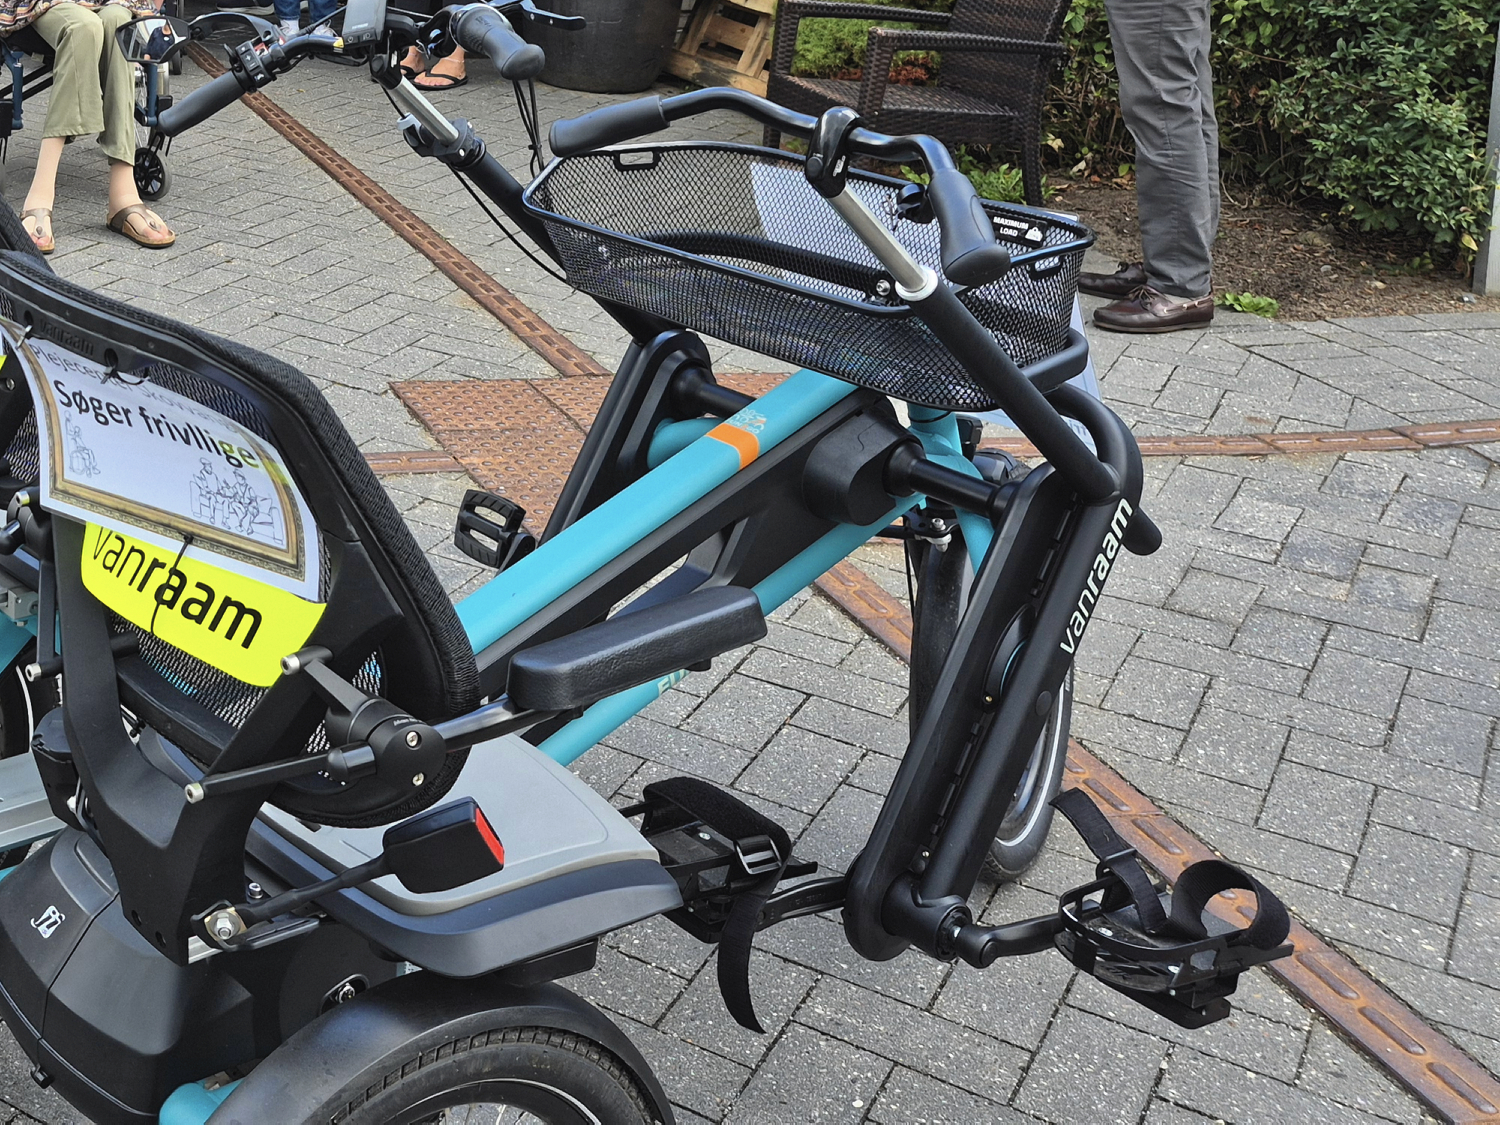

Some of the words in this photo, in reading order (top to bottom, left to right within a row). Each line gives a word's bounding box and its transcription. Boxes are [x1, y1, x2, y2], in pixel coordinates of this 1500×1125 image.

[993, 216, 1029, 230] MAXIMUM
[1000, 227, 1018, 237] LOAD
[53, 379, 134, 426] Søger
[139, 405, 261, 469] frivllige
[93, 526, 263, 650] vanraam
[1060, 498, 1133, 655] vanraam
